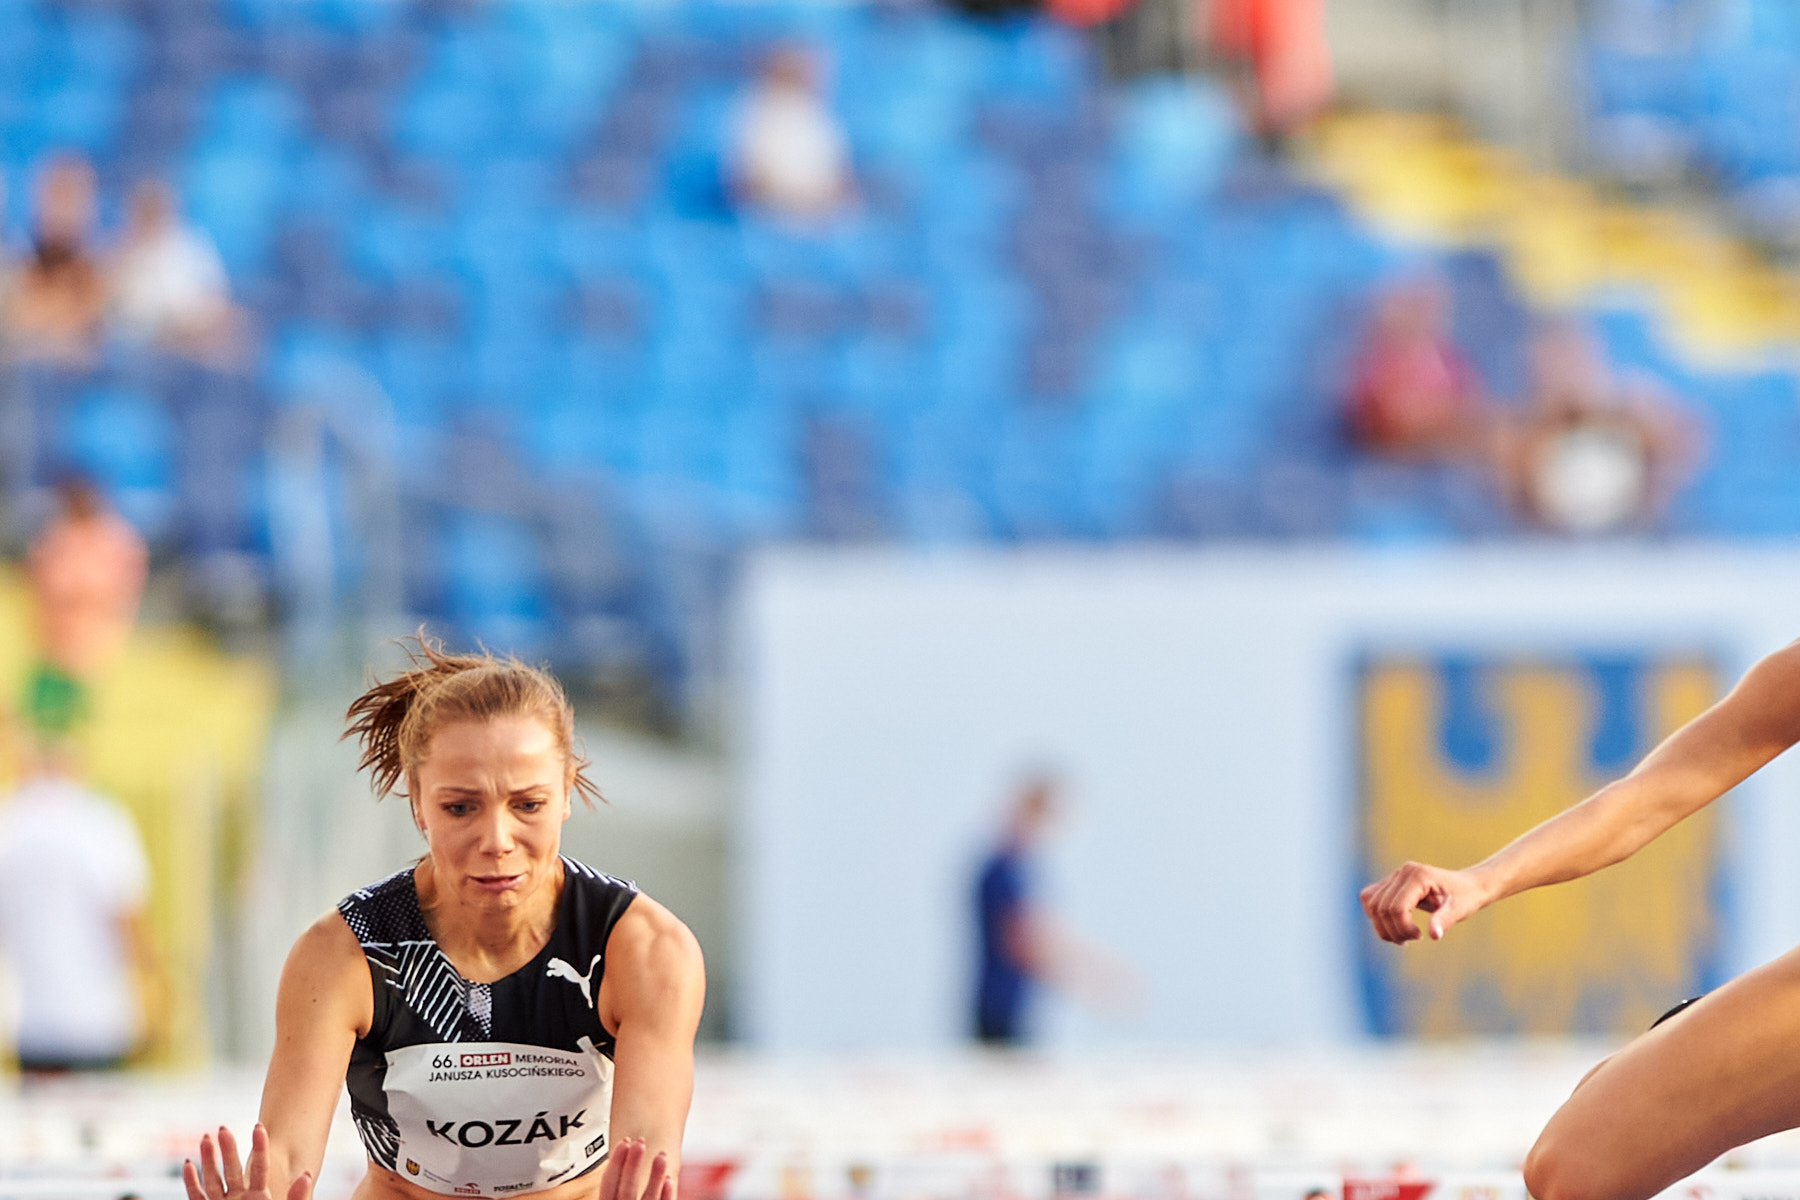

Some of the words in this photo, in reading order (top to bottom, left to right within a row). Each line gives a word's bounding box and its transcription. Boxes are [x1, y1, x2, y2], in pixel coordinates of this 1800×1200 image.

[431, 1054, 458, 1069] 66.
[462, 1054, 510, 1067] ORLEN
[429, 1068, 482, 1082] JANUSZA
[486, 1066, 586, 1080] KUSOCIŃSKIEGO
[426, 1108, 589, 1148] KOZÁK
